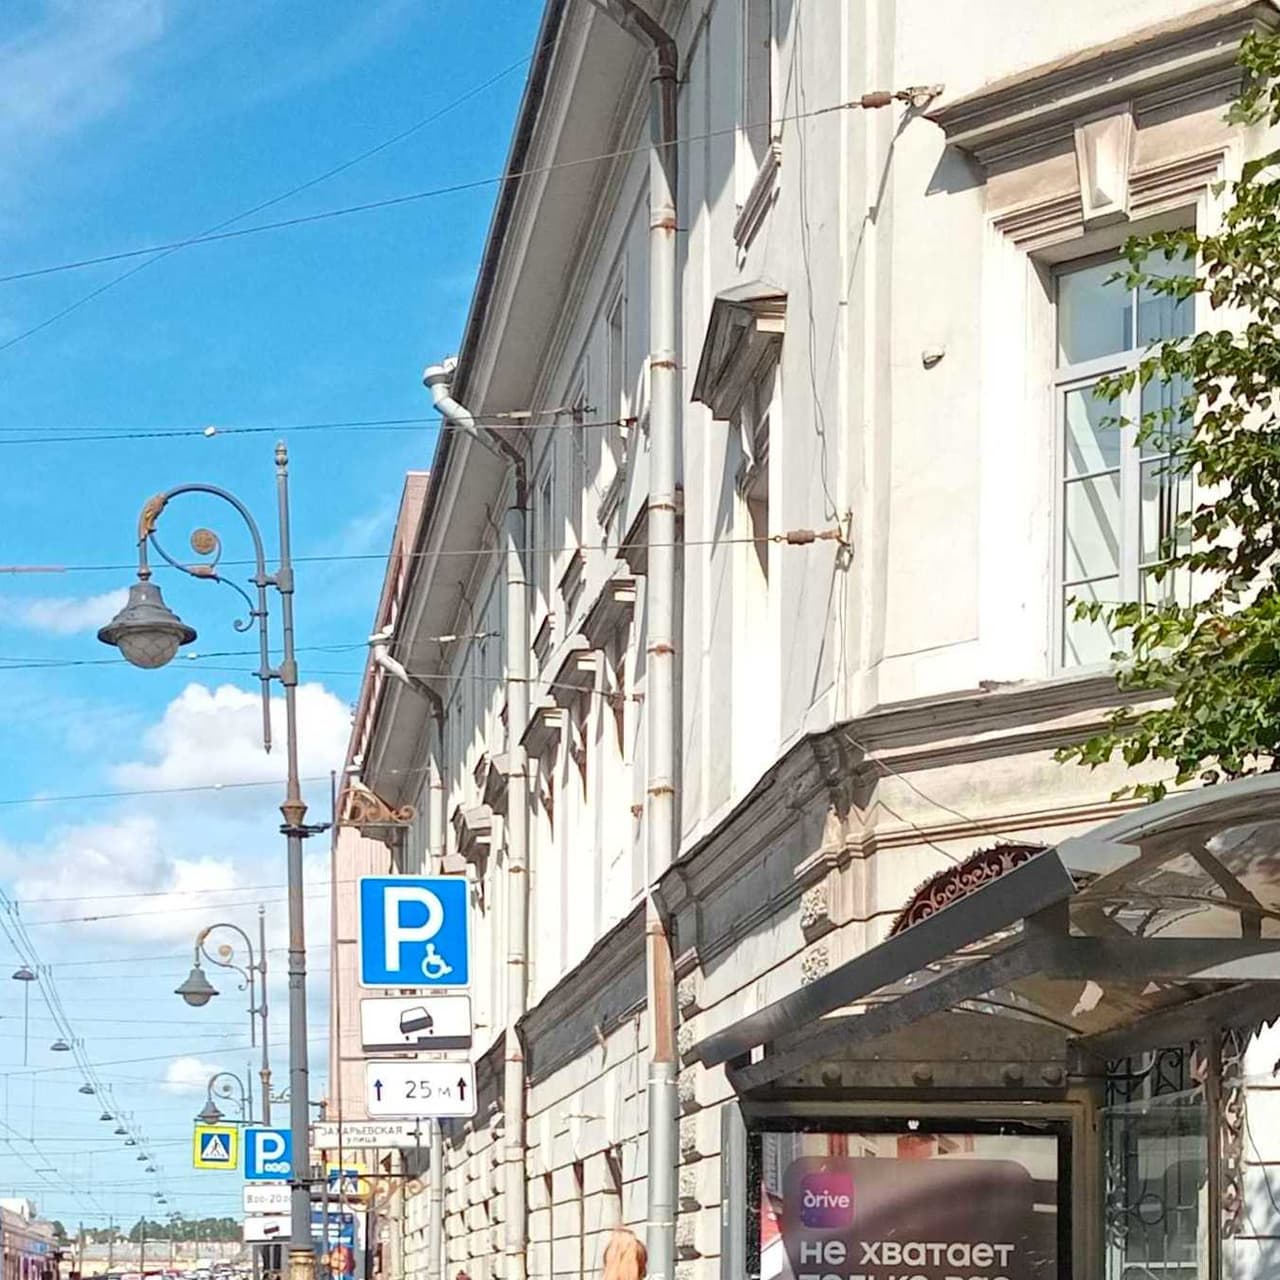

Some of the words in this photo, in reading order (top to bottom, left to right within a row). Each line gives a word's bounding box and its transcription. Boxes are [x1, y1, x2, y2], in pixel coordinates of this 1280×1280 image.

[384, 886, 444, 972] P
[405, 1080, 432, 1099] 25
[255, 1131, 286, 1174] P
[803, 1188, 850, 1209] drive
[800, 1240, 846, 1265] не
[859, 1240, 1015, 1267] хватает
